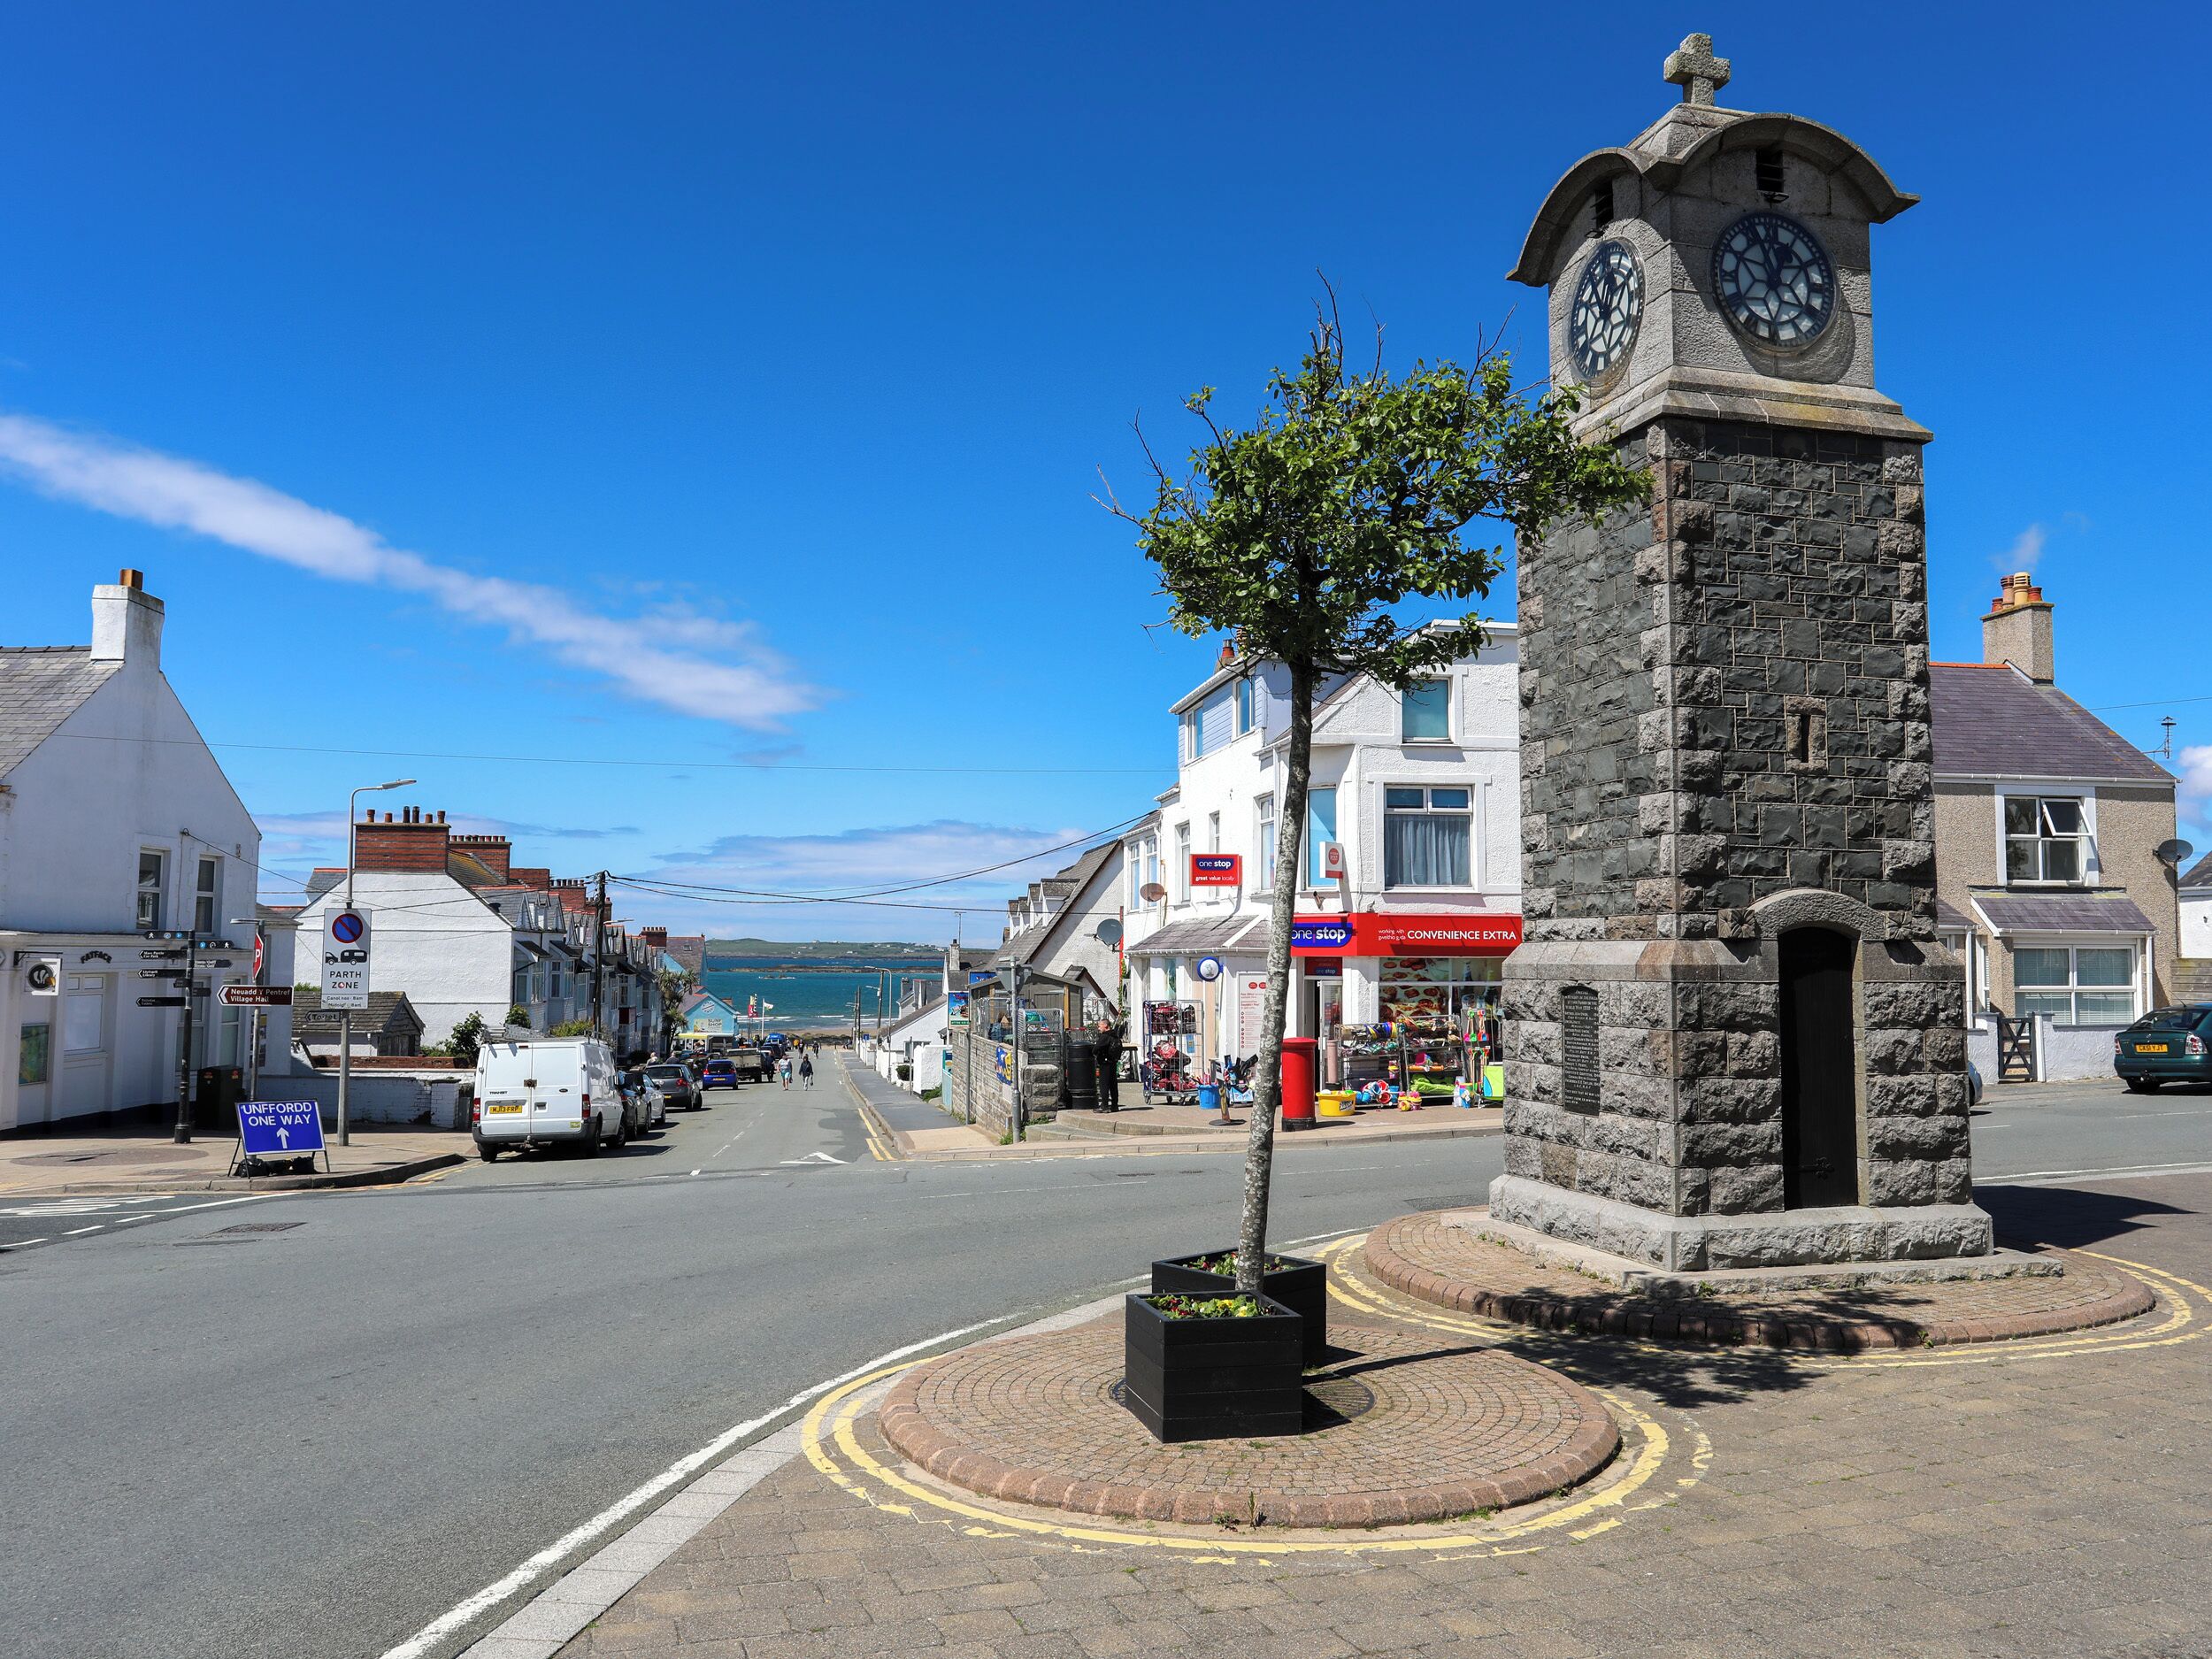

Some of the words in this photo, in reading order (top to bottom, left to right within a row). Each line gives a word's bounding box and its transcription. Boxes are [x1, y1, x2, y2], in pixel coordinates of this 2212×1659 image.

[1213, 860, 1232, 869] stop
[1292, 929, 1313, 940] one
[1316, 926, 1347, 943] stop
[1407, 930, 1480, 940] CONVENIENCE
[1483, 931, 1517, 940] EXTRA
[242, 1102, 311, 1114] UNFFORDD
[248, 1116, 276, 1126] ONE
[280, 1114, 311, 1125] WAY
